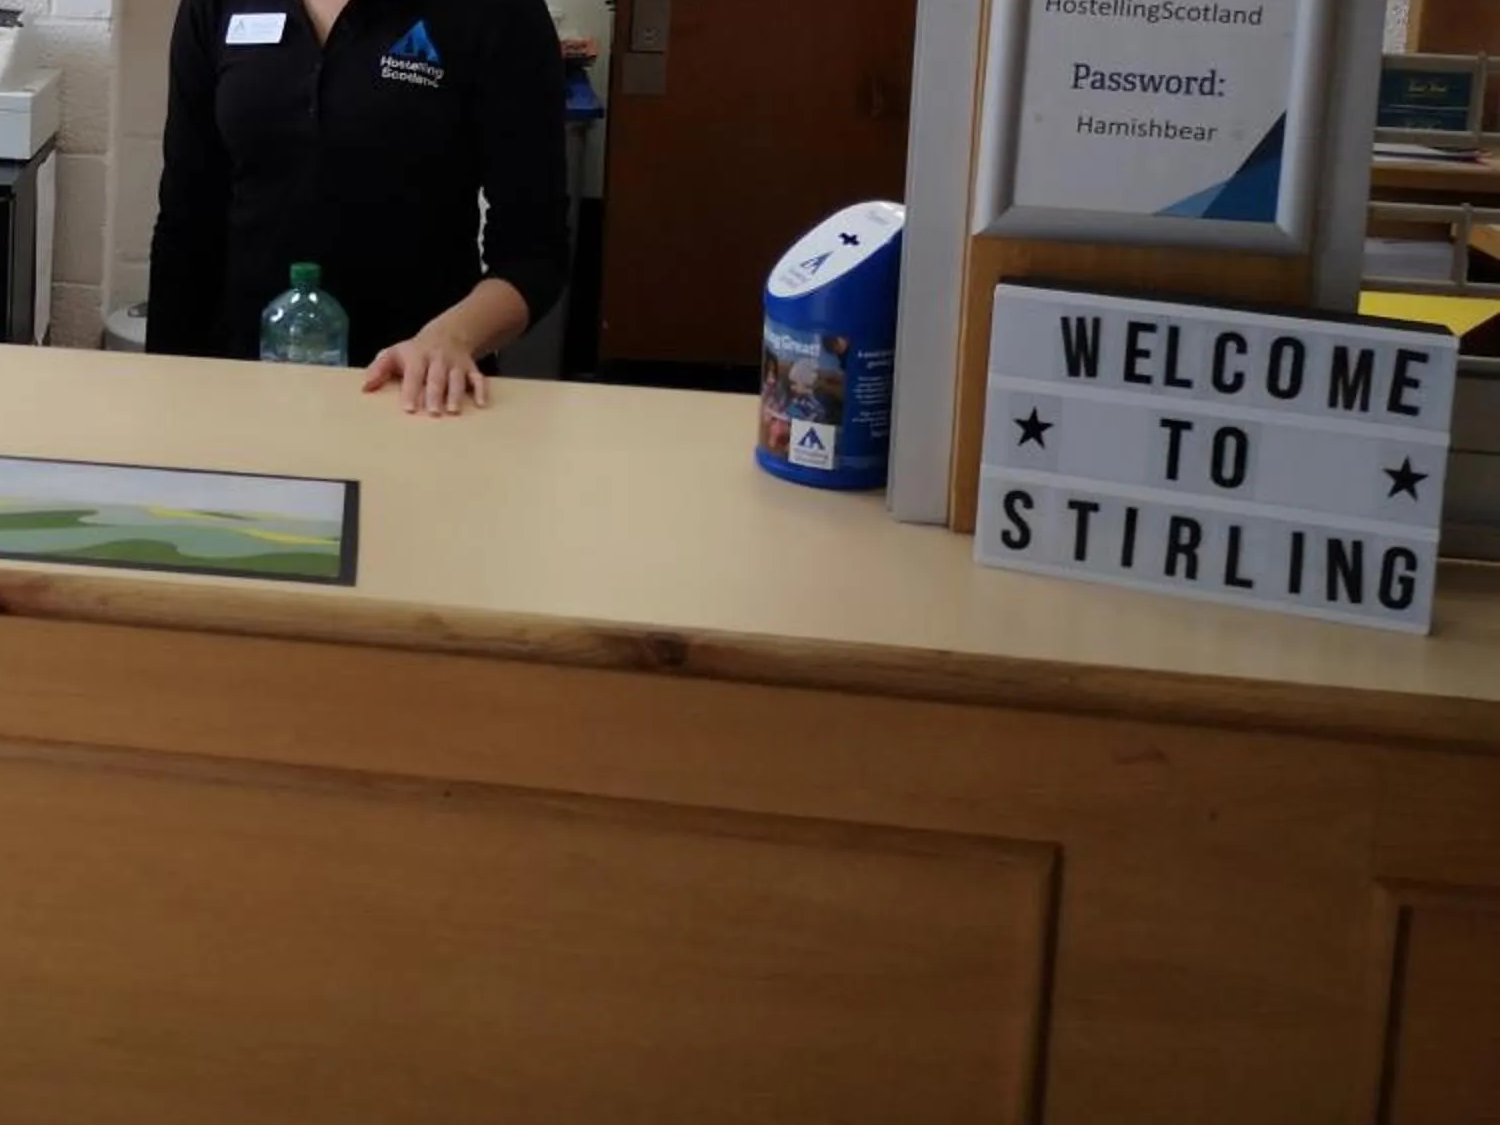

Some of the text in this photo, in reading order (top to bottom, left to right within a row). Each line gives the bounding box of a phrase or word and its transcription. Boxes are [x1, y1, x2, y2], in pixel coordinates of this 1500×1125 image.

[1071, 62, 1227, 98] Password:
[1076, 115, 1219, 143] Hamishbear
[1060, 315, 1430, 417] WELCOME
[1158, 417, 1249, 490] TO
[1000, 489, 1419, 612] STIRLING
